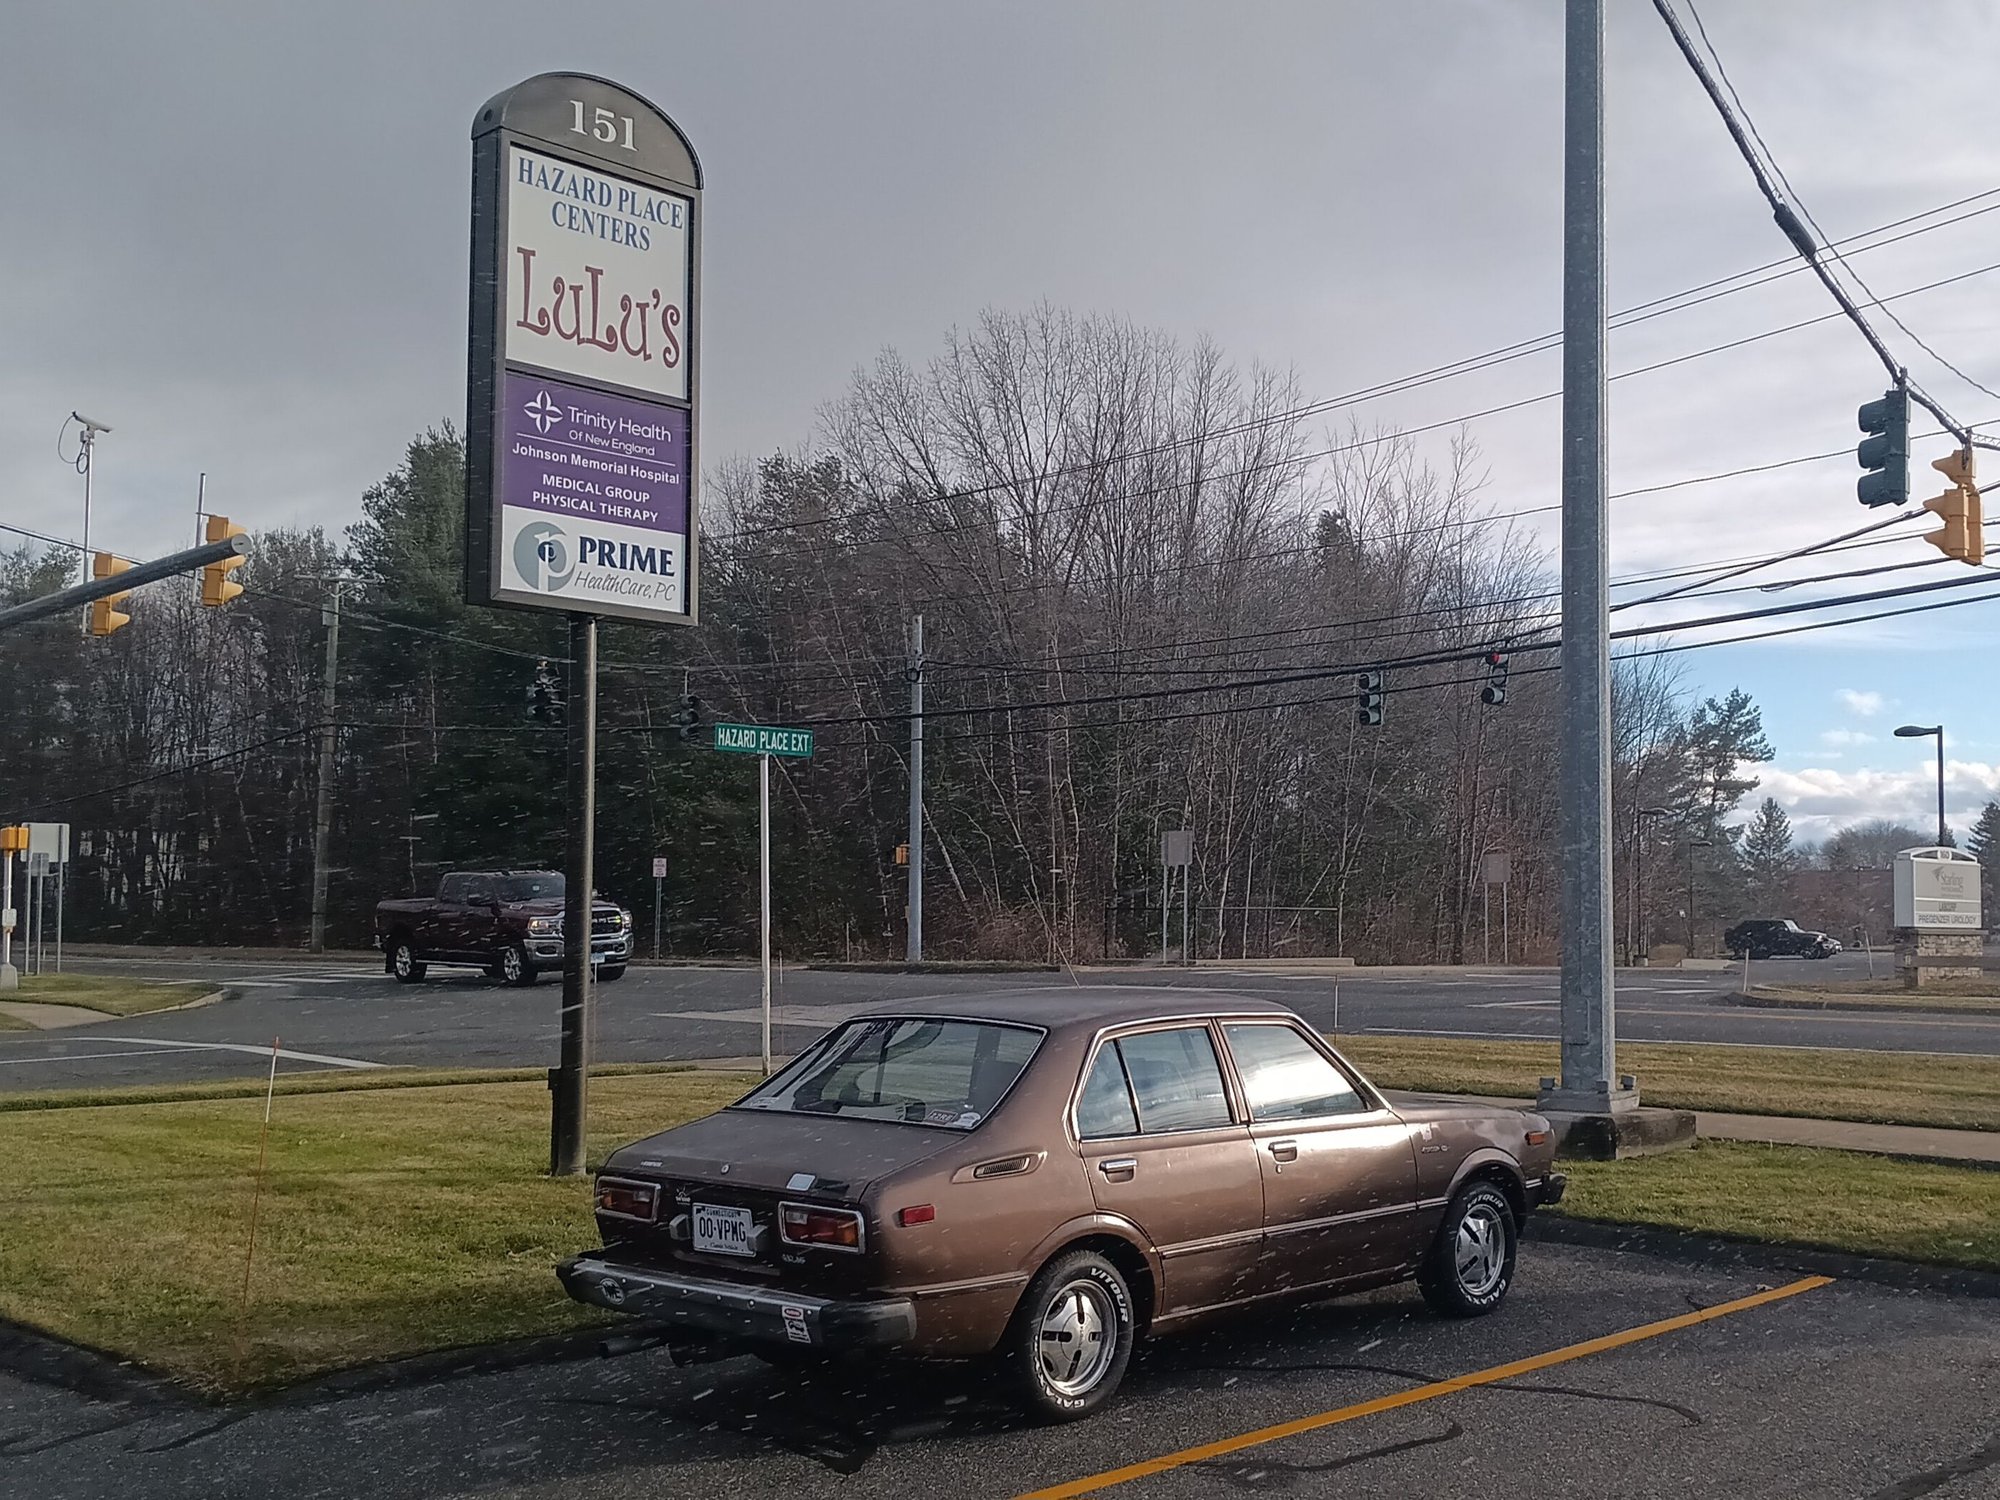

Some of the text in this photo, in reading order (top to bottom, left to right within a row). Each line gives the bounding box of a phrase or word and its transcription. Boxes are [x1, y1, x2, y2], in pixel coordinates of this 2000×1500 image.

[569, 99, 638, 151] 151
[518, 156, 683, 229] HAZARD PLACE
[552, 201, 650, 251] CENTERS
[567, 406, 671, 442] Trinity Health
[569, 429, 655, 456] Of New England
[512, 442, 679, 485] Johnson Memorial Hospital
[532, 490, 658, 523] PHYSICAL THERAPY
[542, 473, 650, 503] MEDICAL GROUP
[579, 535, 675, 577] PRIME
[718, 728, 809, 752] HAZARD PLACE EXT
[1951, 915, 1977, 924] UROLOGY
[1091, 1267, 1129, 1323] VITOUR
